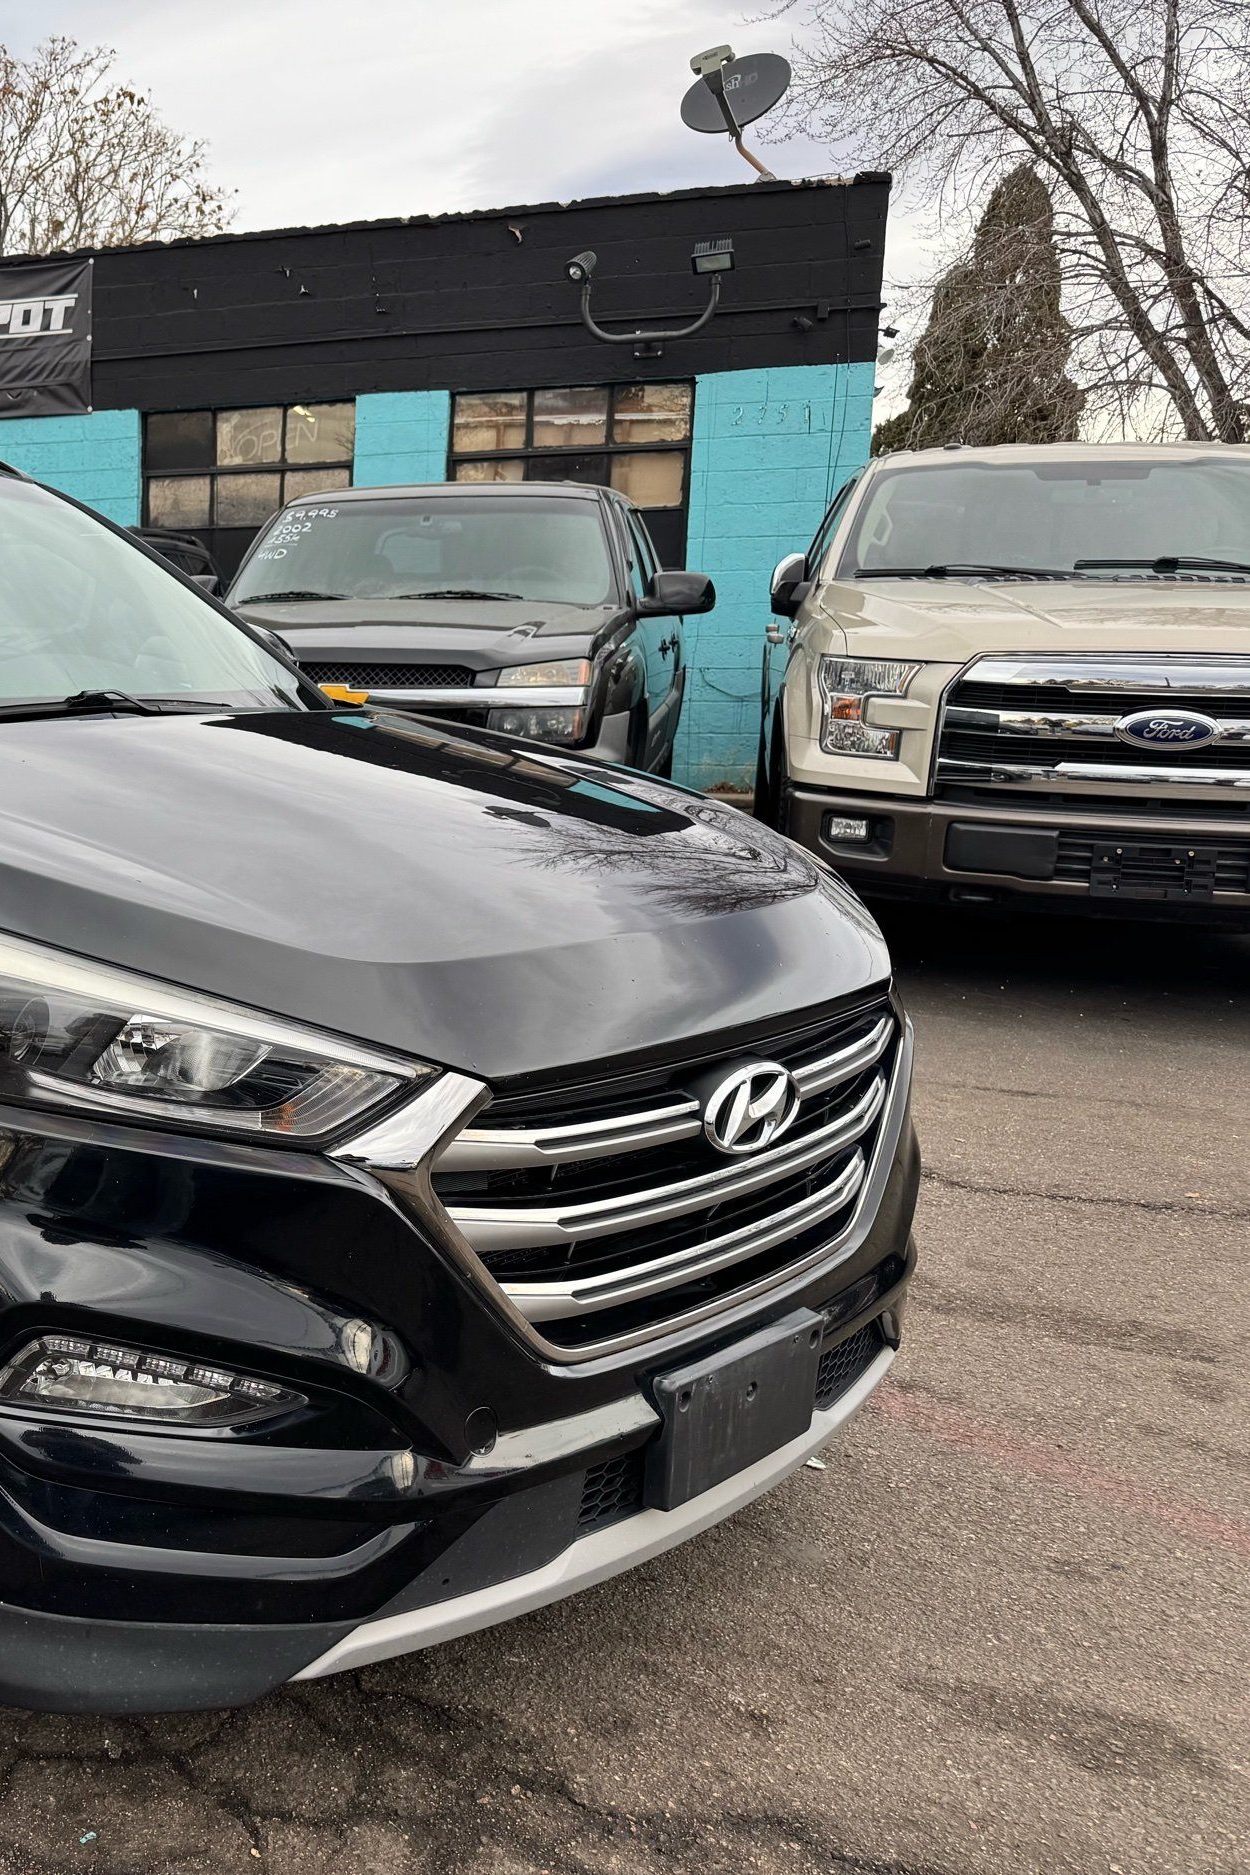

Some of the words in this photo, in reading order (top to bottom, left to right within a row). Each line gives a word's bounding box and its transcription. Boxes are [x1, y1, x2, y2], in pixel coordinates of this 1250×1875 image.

[237, 420, 318, 459] OPEN
[273, 522, 312, 536] 2002
[258, 548, 287, 560] 4WD
[1143, 719, 1196, 740] Ford
